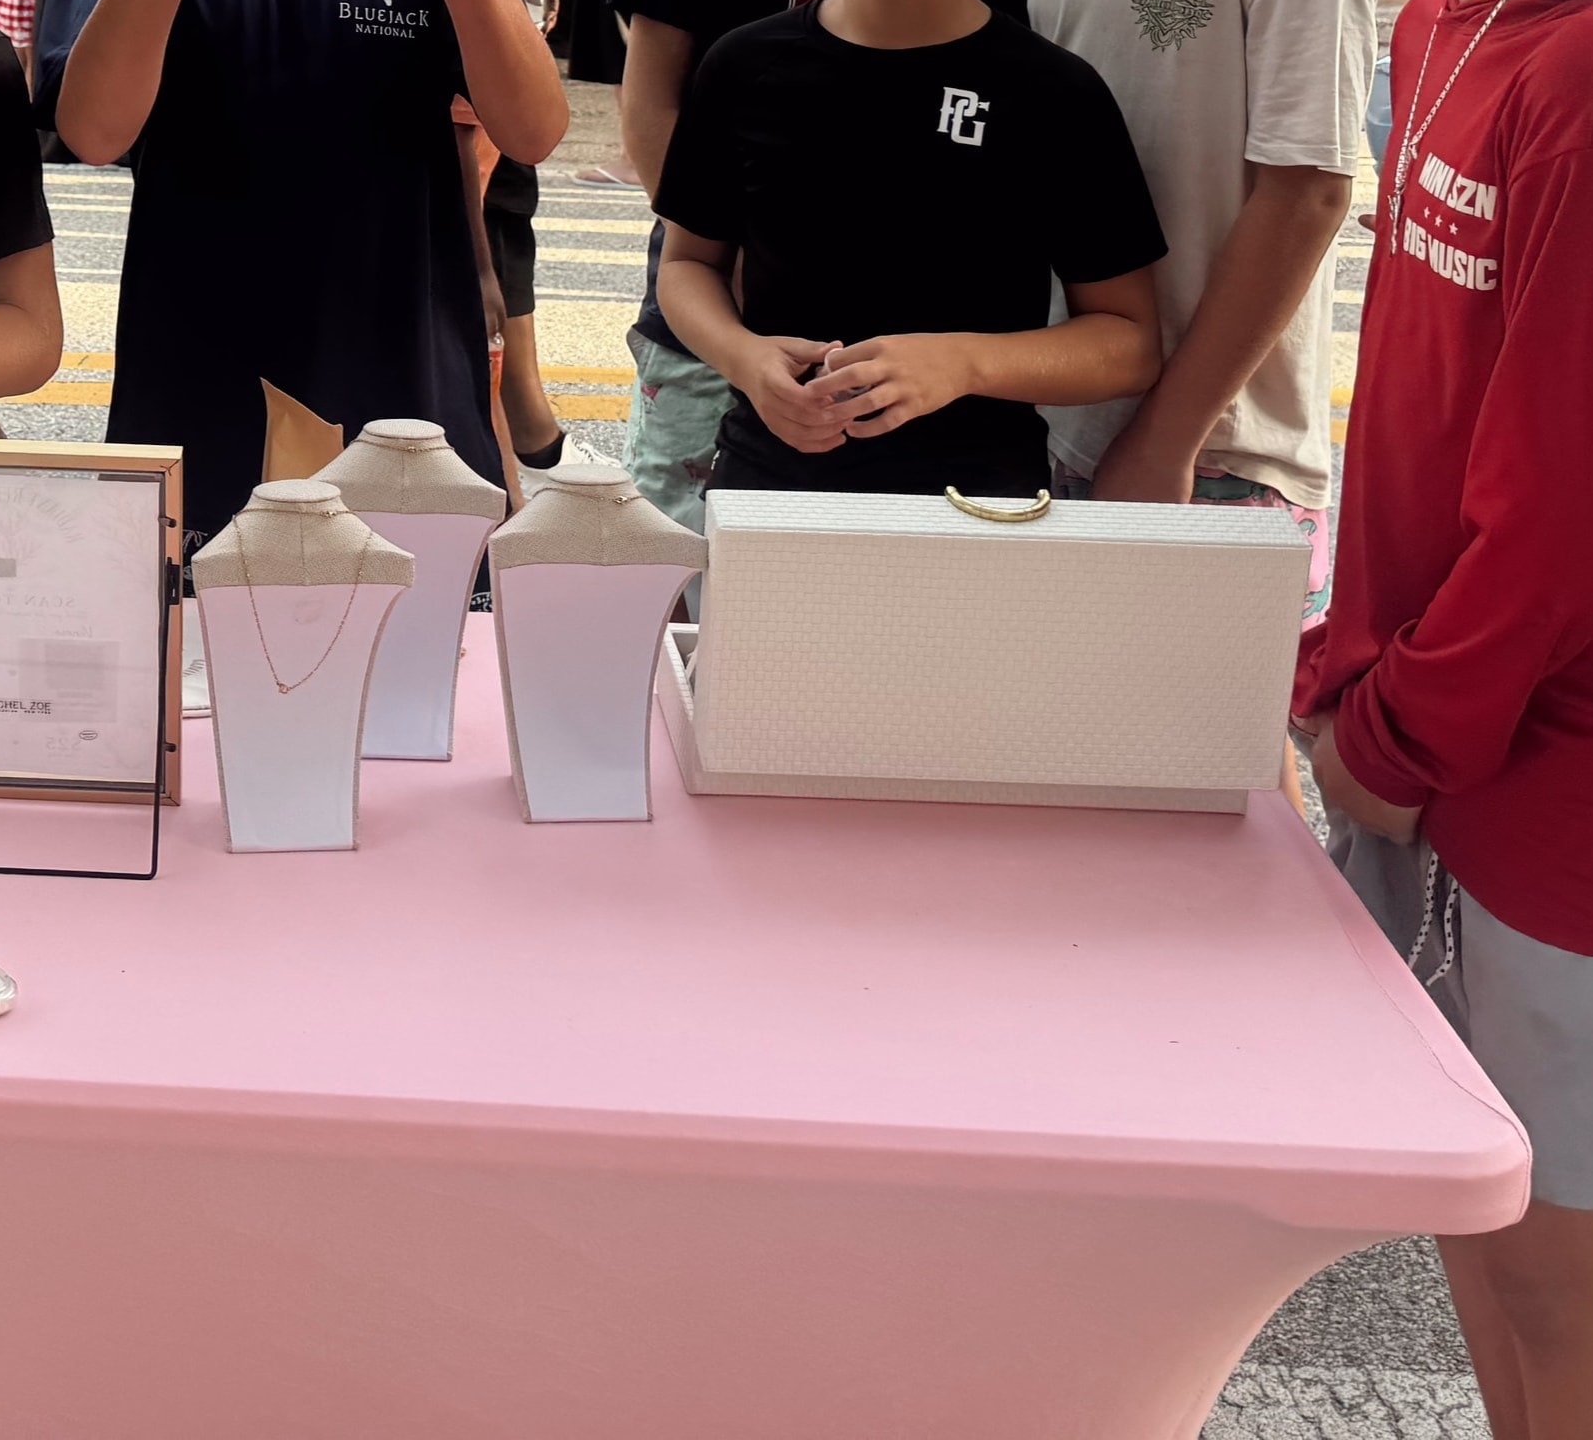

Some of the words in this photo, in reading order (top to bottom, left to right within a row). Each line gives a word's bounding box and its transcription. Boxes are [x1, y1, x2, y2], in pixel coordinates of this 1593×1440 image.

[355, 23, 415, 39] NATIONAL
[936, 86, 991, 146] PG
[29, 701, 52, 712] ZOE
